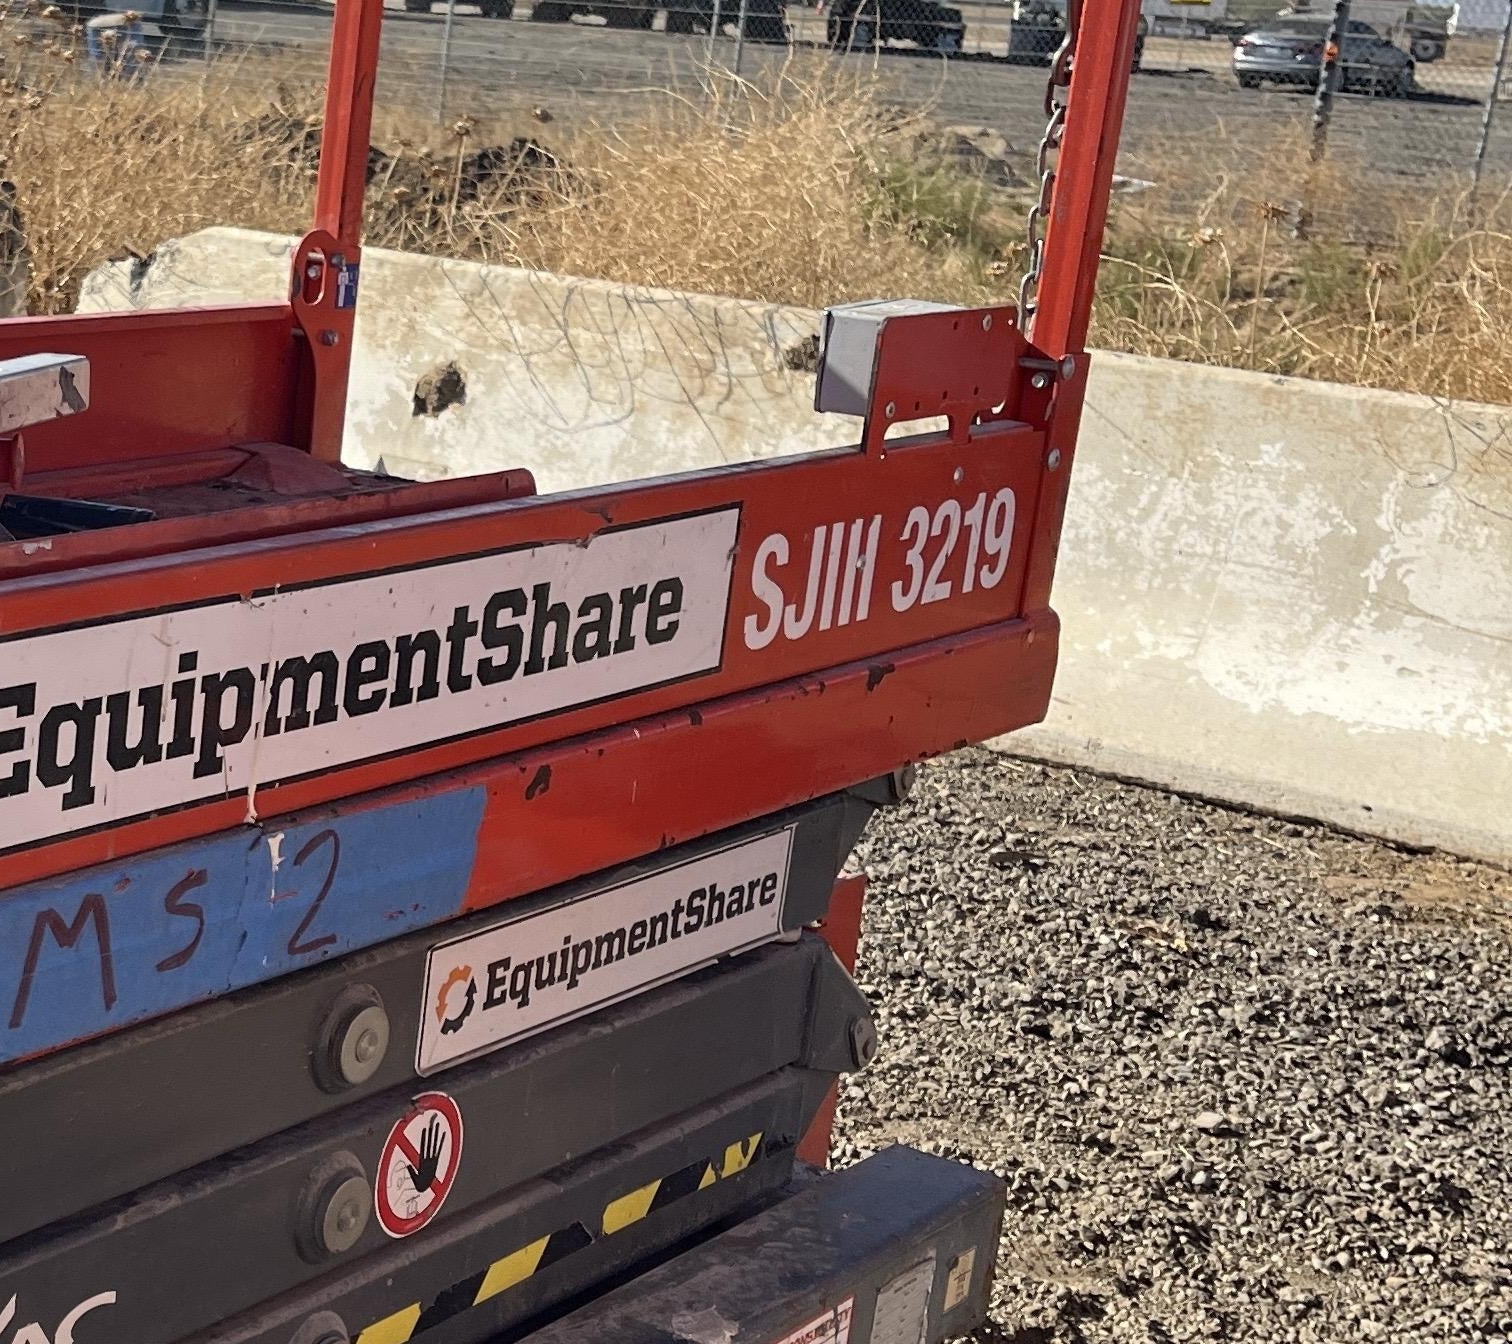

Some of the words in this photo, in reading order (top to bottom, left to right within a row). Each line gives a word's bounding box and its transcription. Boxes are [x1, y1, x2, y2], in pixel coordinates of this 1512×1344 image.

[891, 487, 1016, 613] 3219
[287, 829, 340, 956] 2
[482, 871, 779, 1011] EquipmentShare
